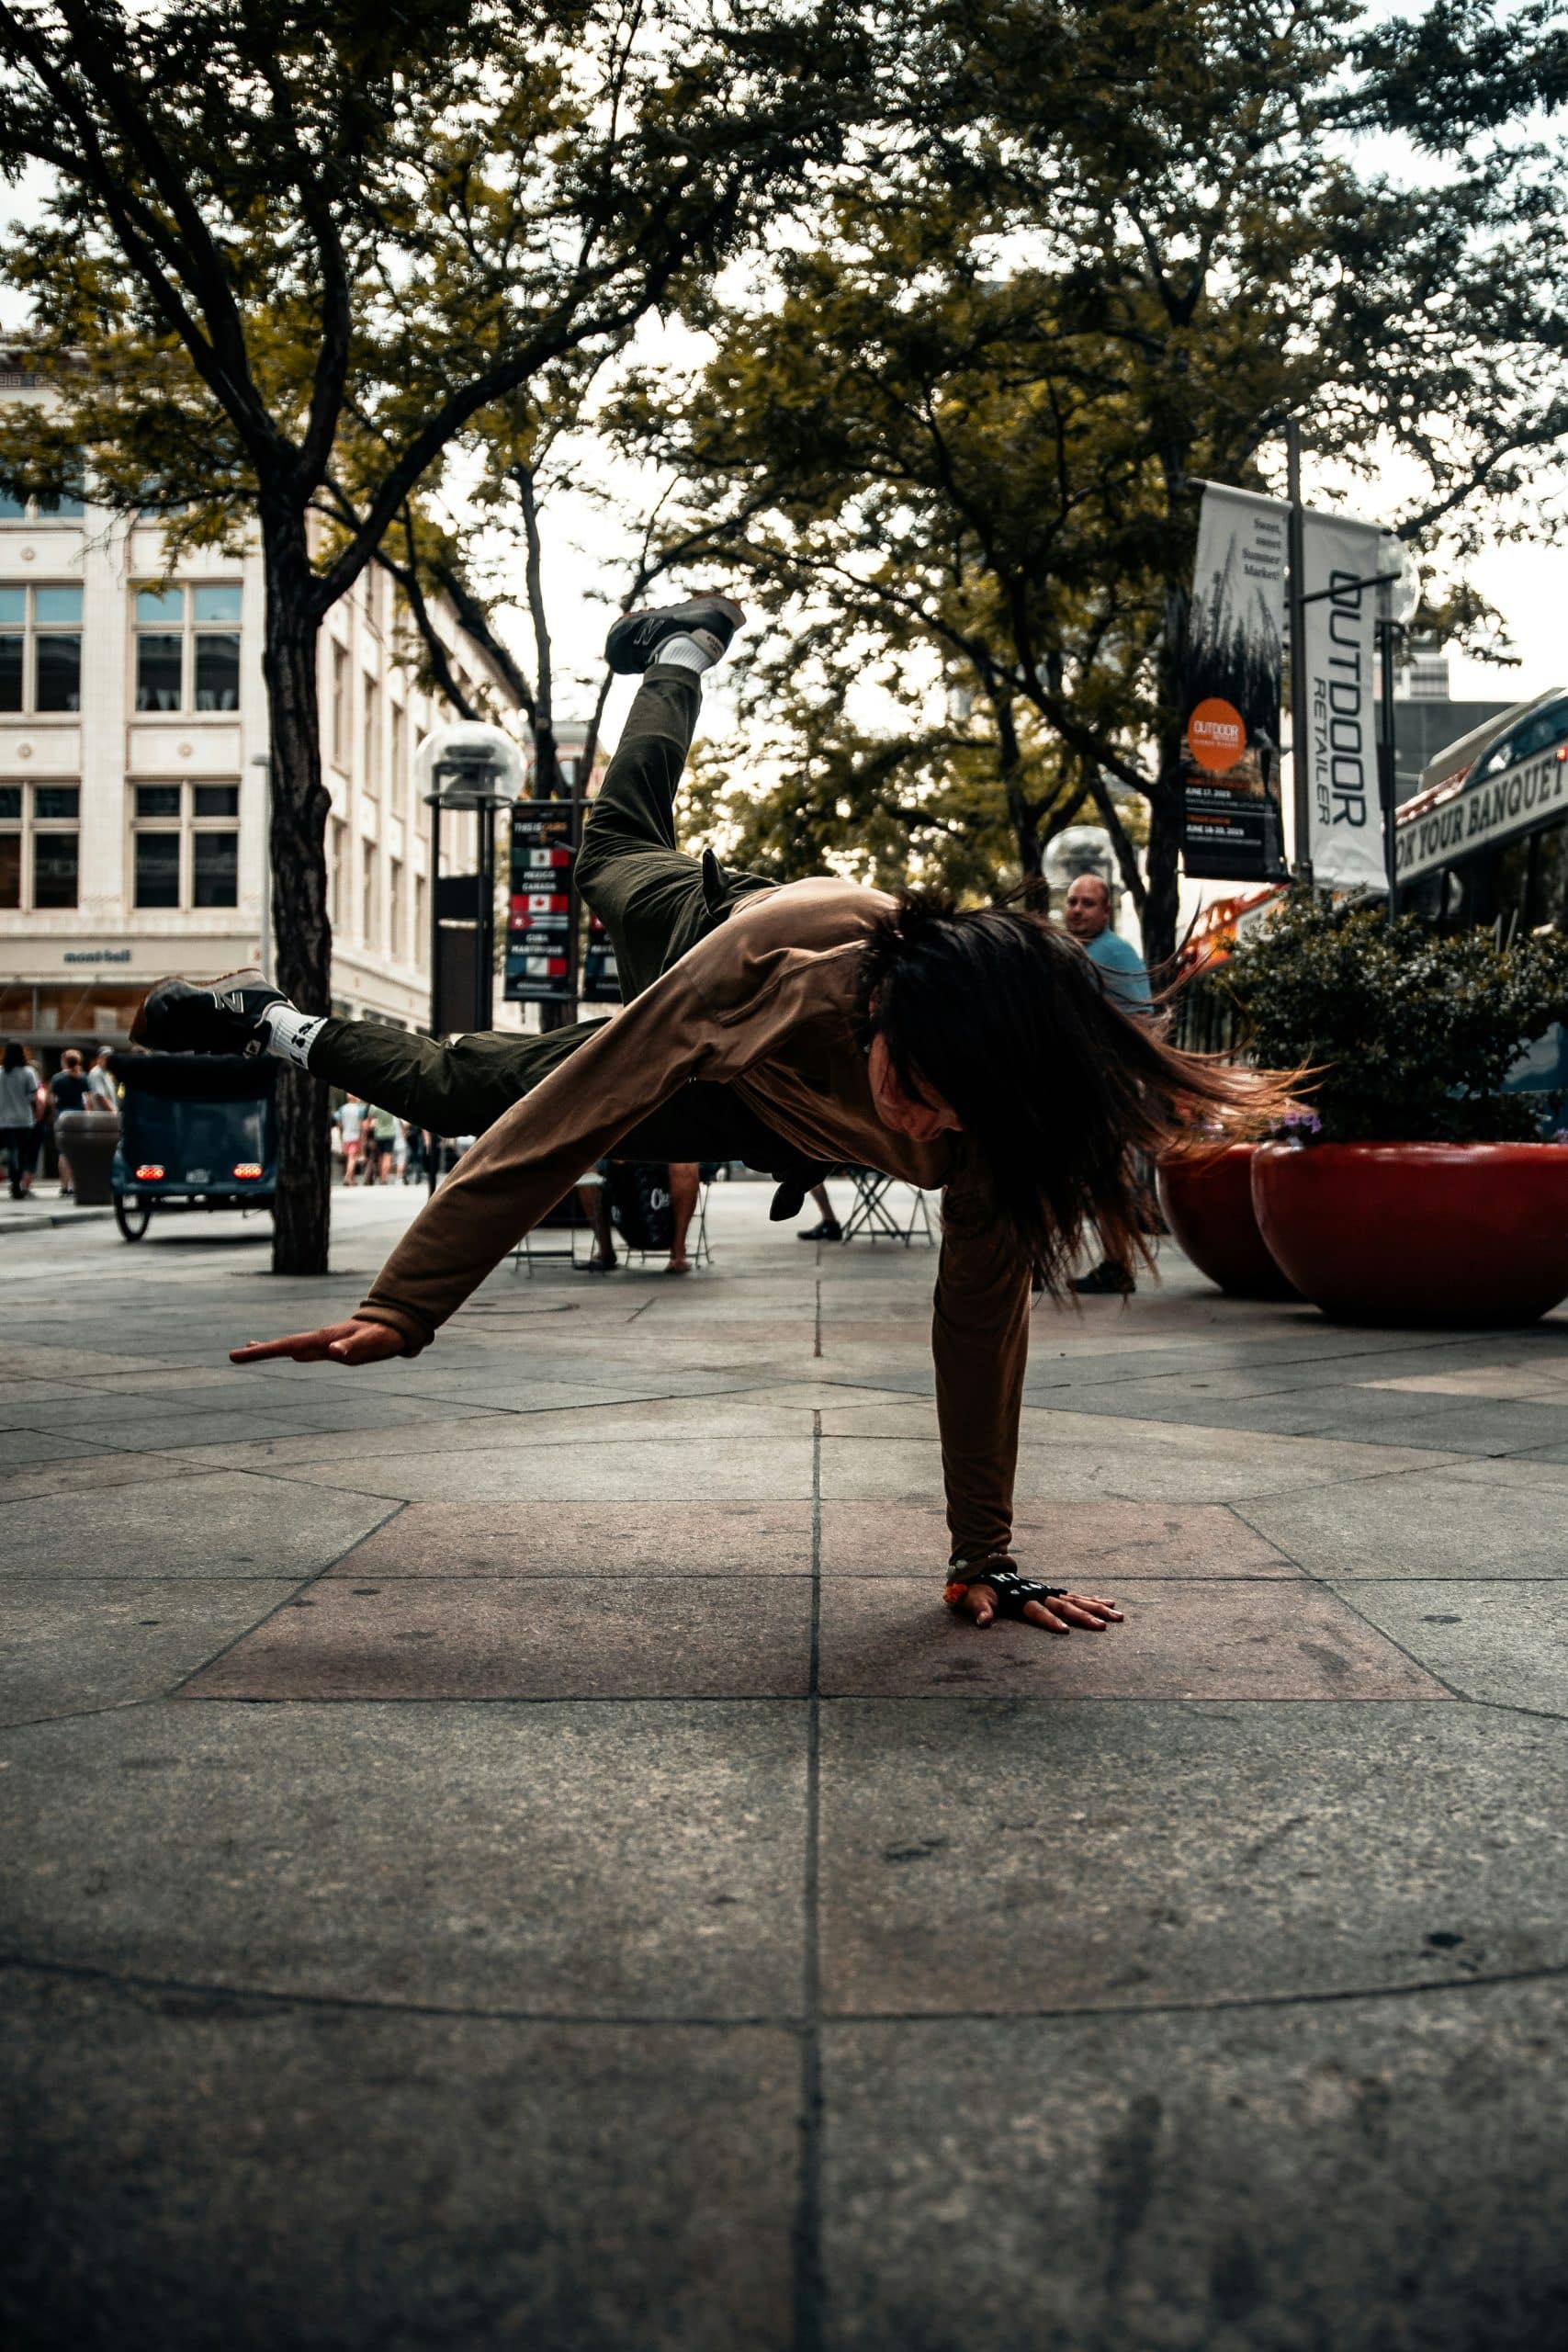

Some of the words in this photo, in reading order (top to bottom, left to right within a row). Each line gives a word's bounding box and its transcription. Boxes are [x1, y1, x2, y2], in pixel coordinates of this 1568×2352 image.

[1314, 676, 1330, 826] RETAILER
[1329, 569, 1367, 828] OUTDOOR
[1418, 803, 1463, 860] YOUR
[1467, 754, 1564, 837] BANQUET
[522, 882, 557, 891] CANADA
[525, 933, 548, 944] CUBA
